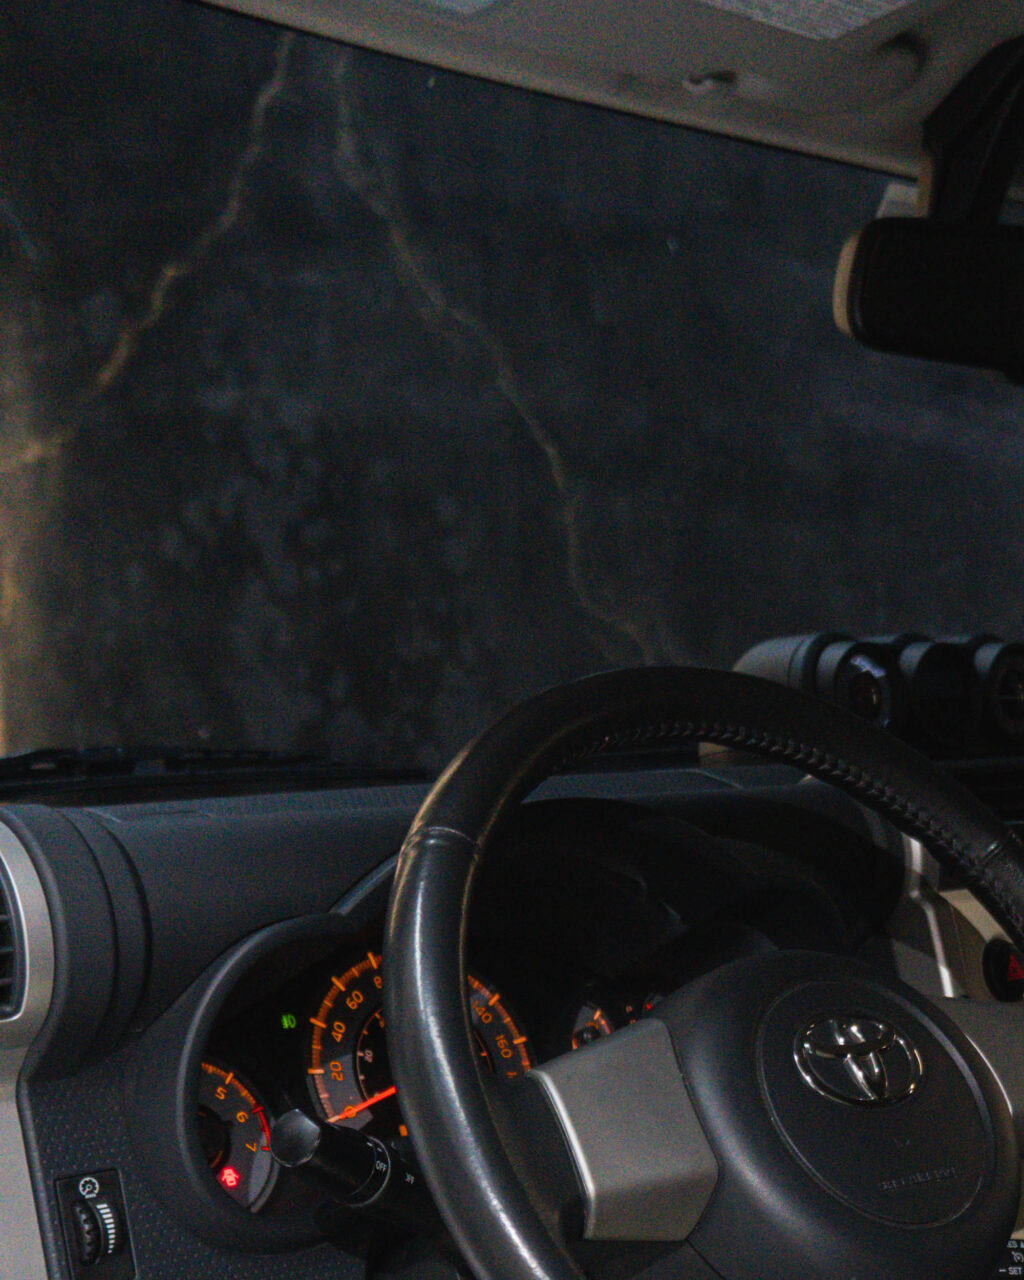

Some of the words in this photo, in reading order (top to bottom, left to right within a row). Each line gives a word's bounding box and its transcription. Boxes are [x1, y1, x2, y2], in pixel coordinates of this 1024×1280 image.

[346, 989, 364, 1010] 60
[473, 1000, 492, 1024] 140
[331, 1020, 346, 1043] 40
[496, 1034, 512, 1059] 160
[329, 1060, 343, 1081] 20
[214, 1085, 228, 1100] 5
[236, 1111, 249, 1123] 6
[245, 1142, 257, 1152] 7
[375, 1160, 388, 1173] OFF
